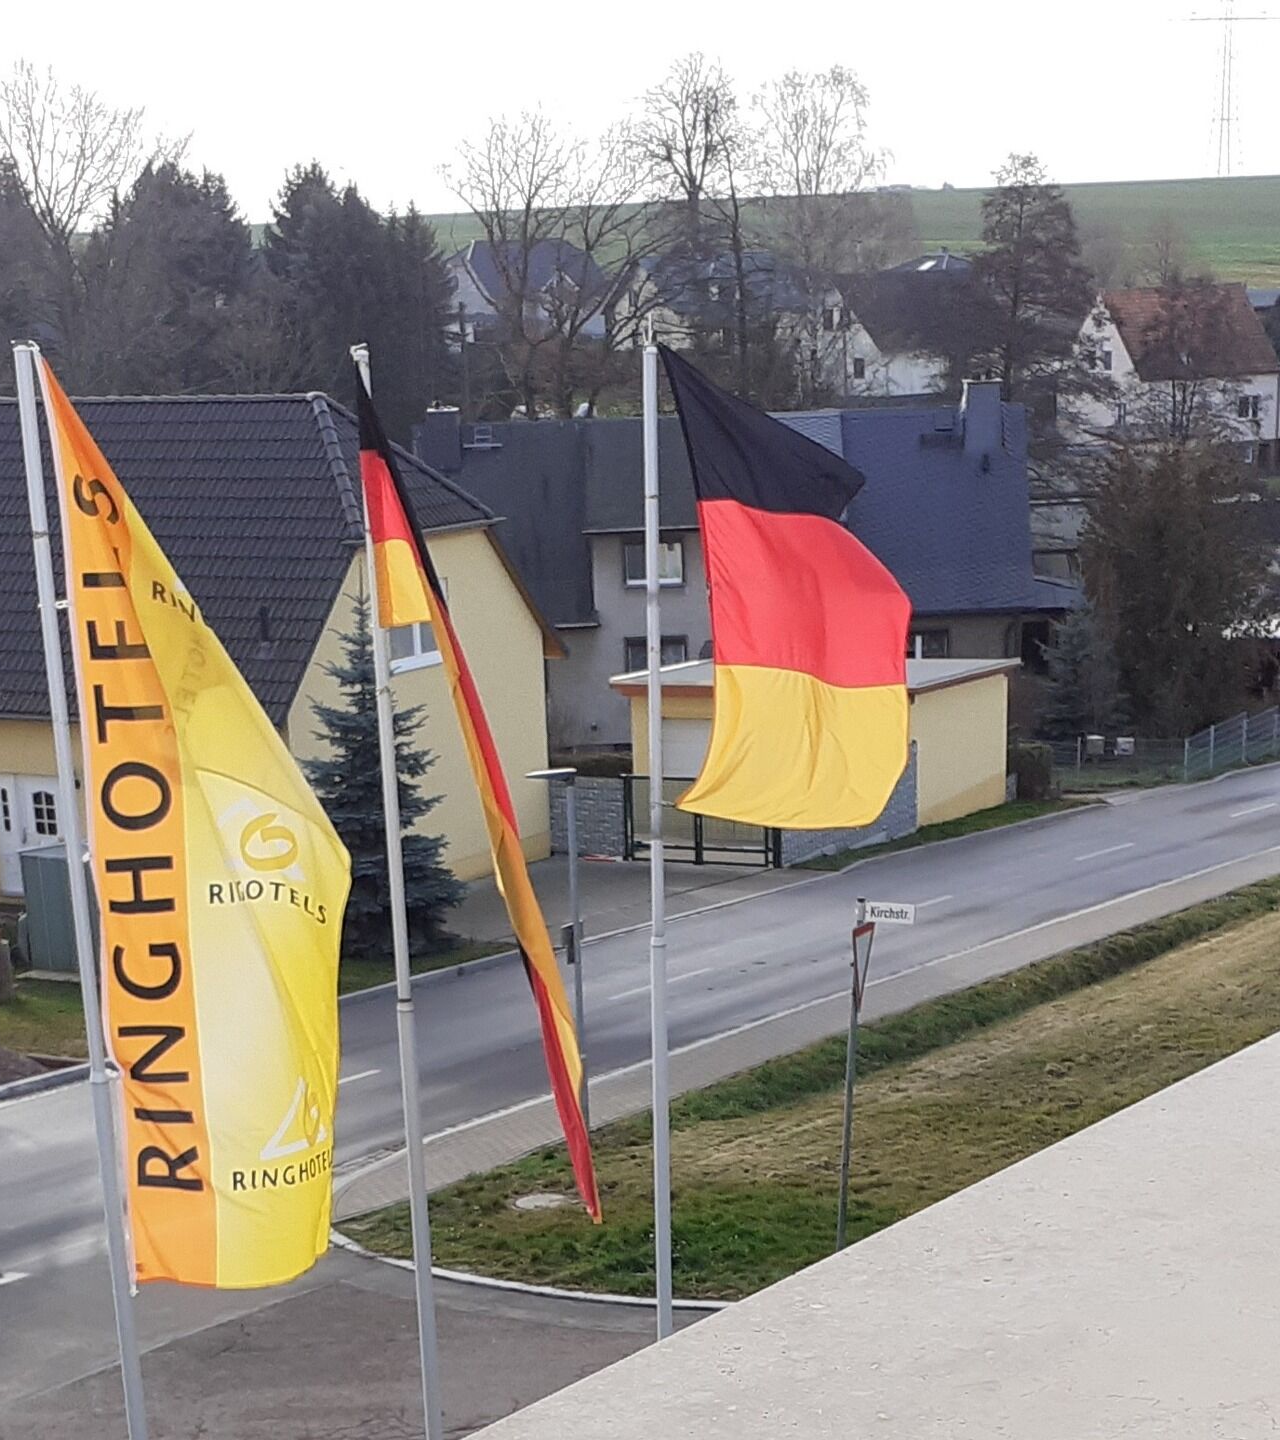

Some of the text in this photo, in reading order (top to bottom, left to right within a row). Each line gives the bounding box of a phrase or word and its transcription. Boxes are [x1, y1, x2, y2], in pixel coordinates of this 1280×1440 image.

[208, 879, 327, 925] RIOTELS
[870, 905, 911, 920] Kirchstr.
[232, 1148, 333, 1191] RINGHOTEL
